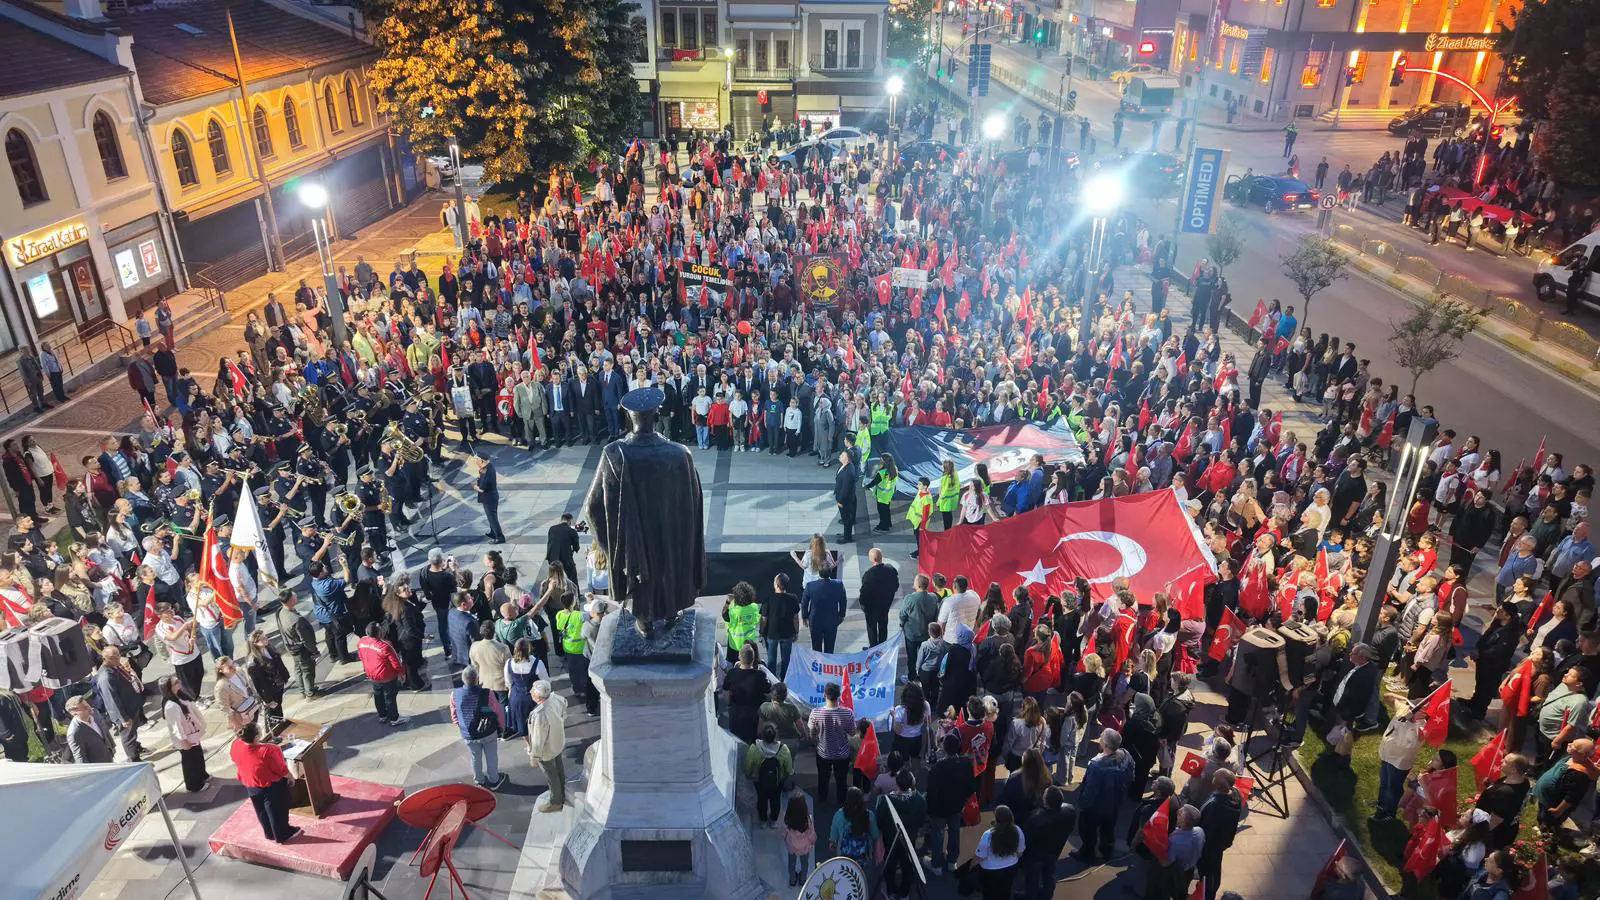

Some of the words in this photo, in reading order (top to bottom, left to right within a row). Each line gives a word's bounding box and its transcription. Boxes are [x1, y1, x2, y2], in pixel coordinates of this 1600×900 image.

[1437, 36, 1464, 49] Ziraat
[1190, 162, 1214, 228] OPTİMED
[28, 236, 58, 258] Ziraat
[868, 686, 887, 699] Ne
[119, 795, 147, 828] Edirne
